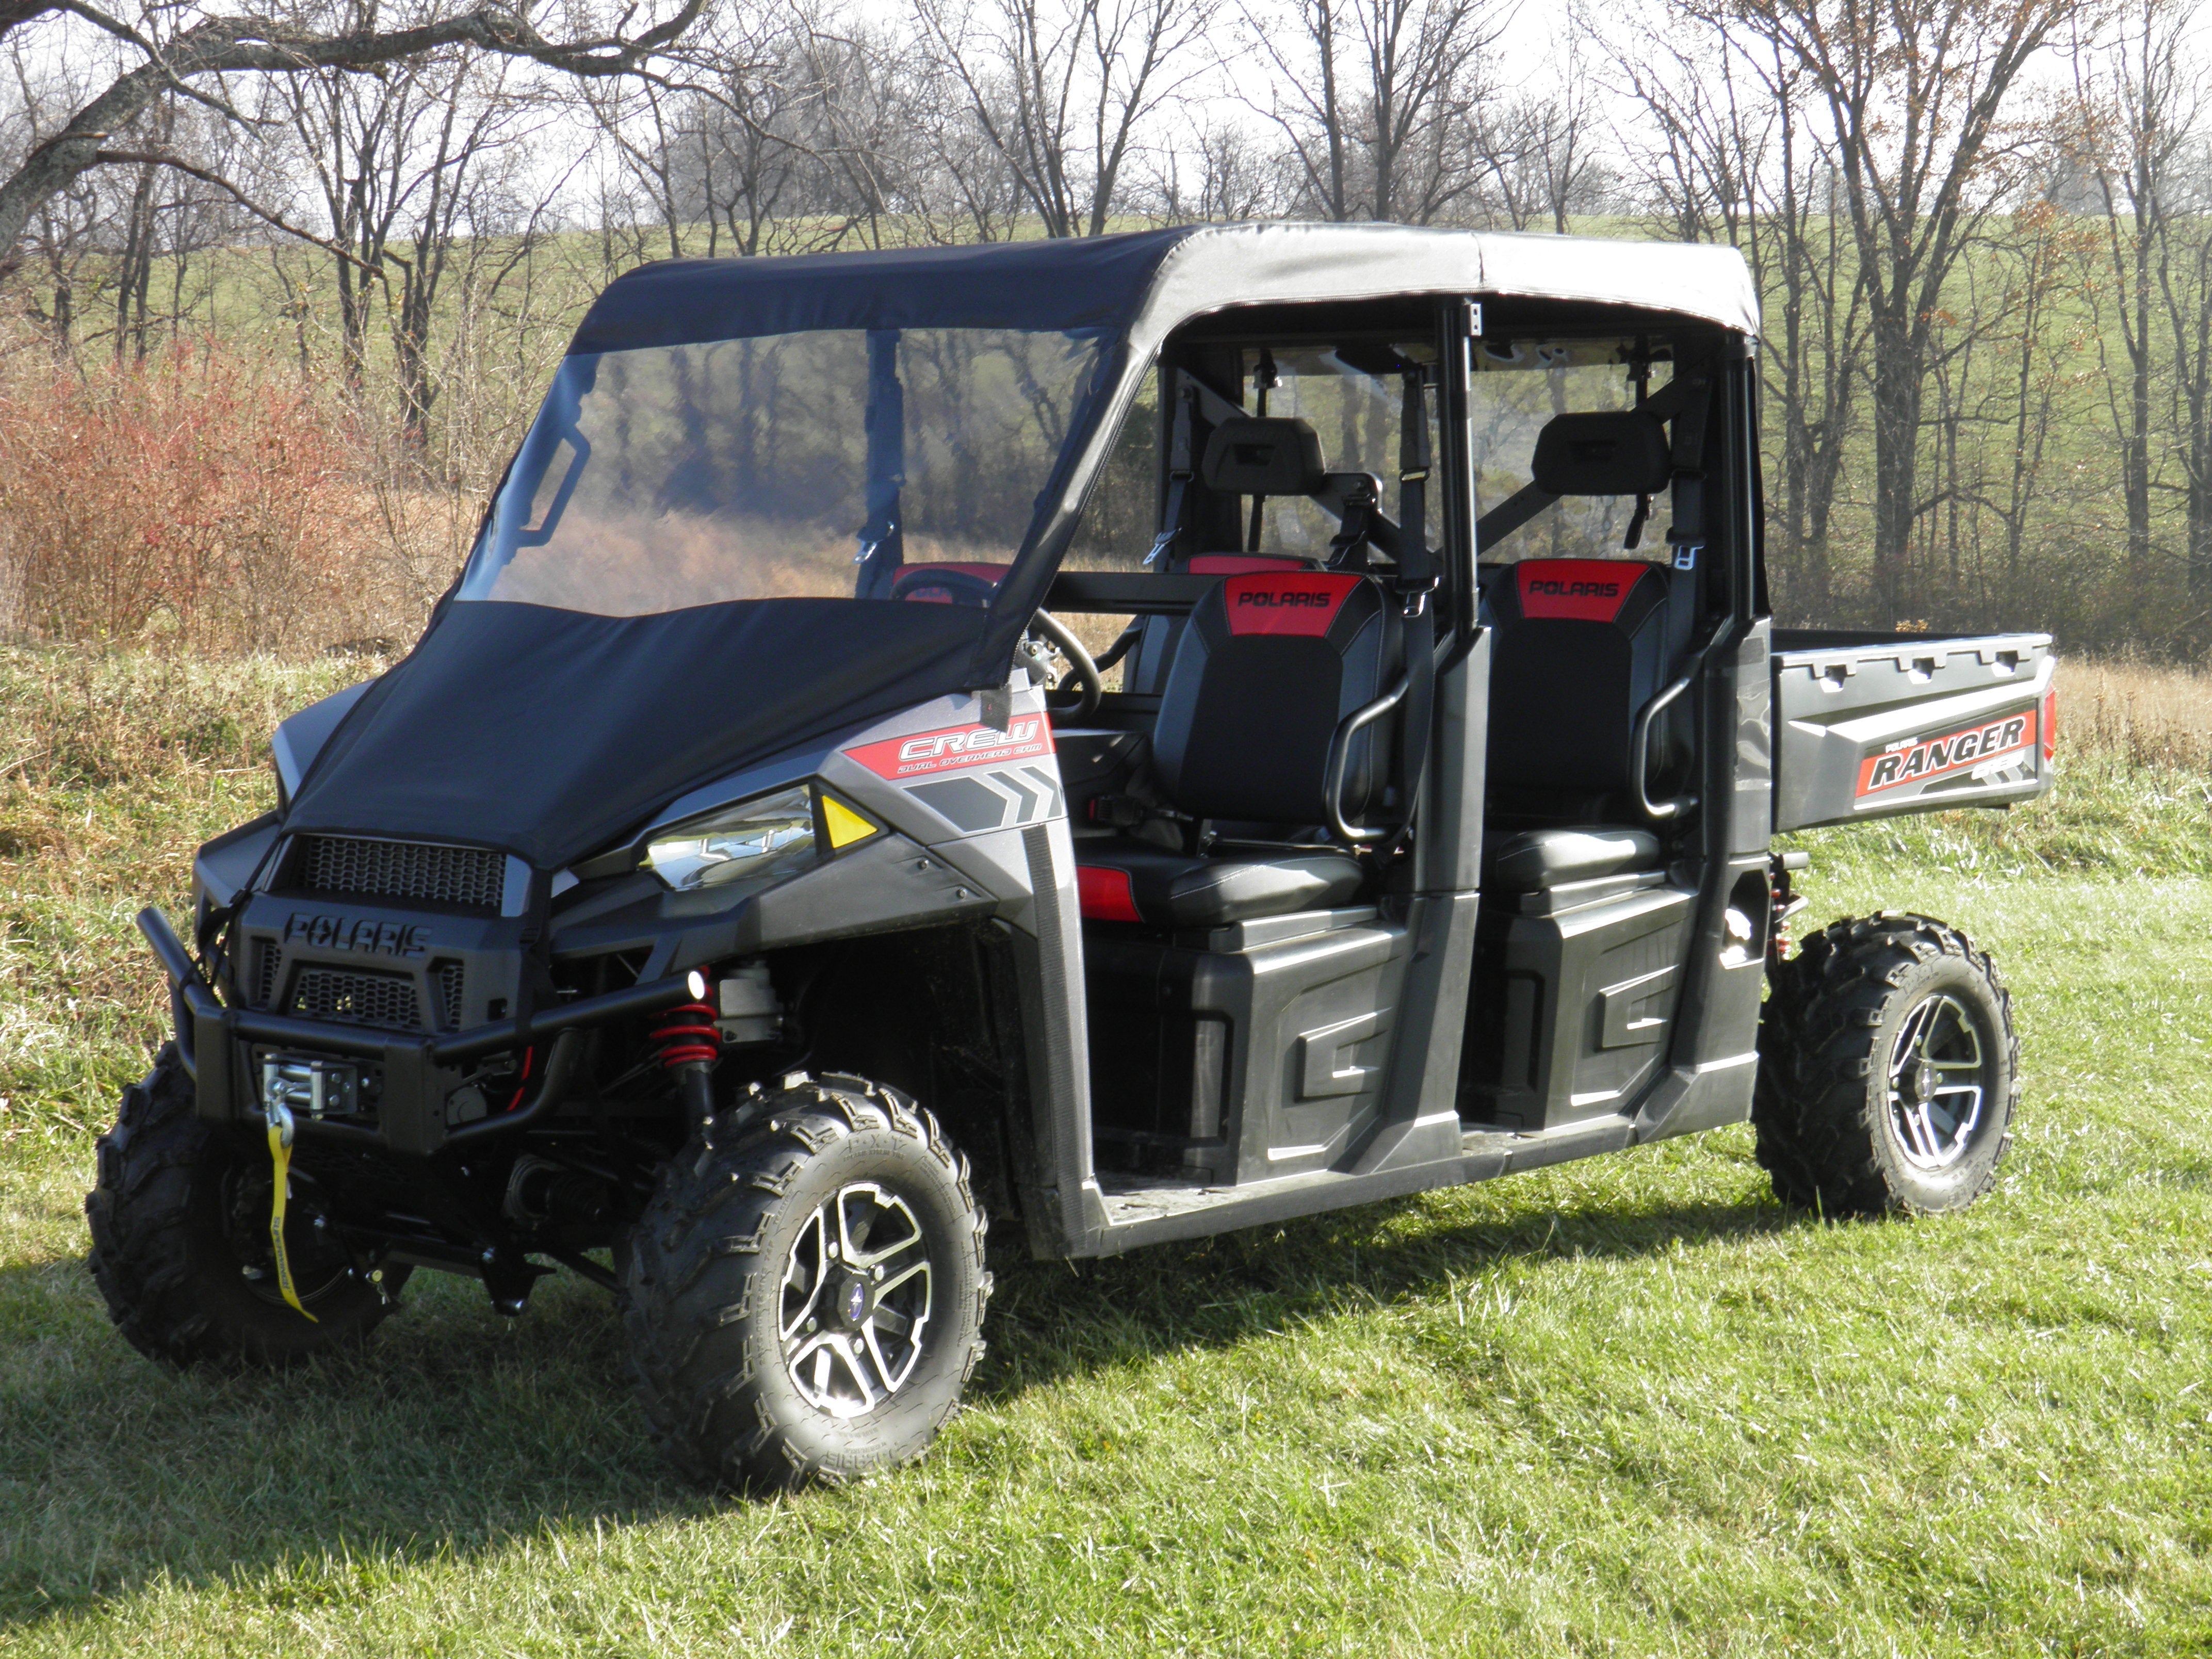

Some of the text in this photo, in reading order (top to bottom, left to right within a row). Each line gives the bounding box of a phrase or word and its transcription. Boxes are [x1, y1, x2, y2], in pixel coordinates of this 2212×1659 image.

[1238, 592, 1331, 608] POLARIS
[1529, 580, 1620, 598] POLARIS
[899, 720, 1039, 761] CREW
[1867, 715, 2025, 791] RANGER
[1885, 737, 1918, 754] POLARIS
[897, 743, 1043, 774] DUAL OVERHEAD CAM
[283, 913, 432, 958] POLARIS
